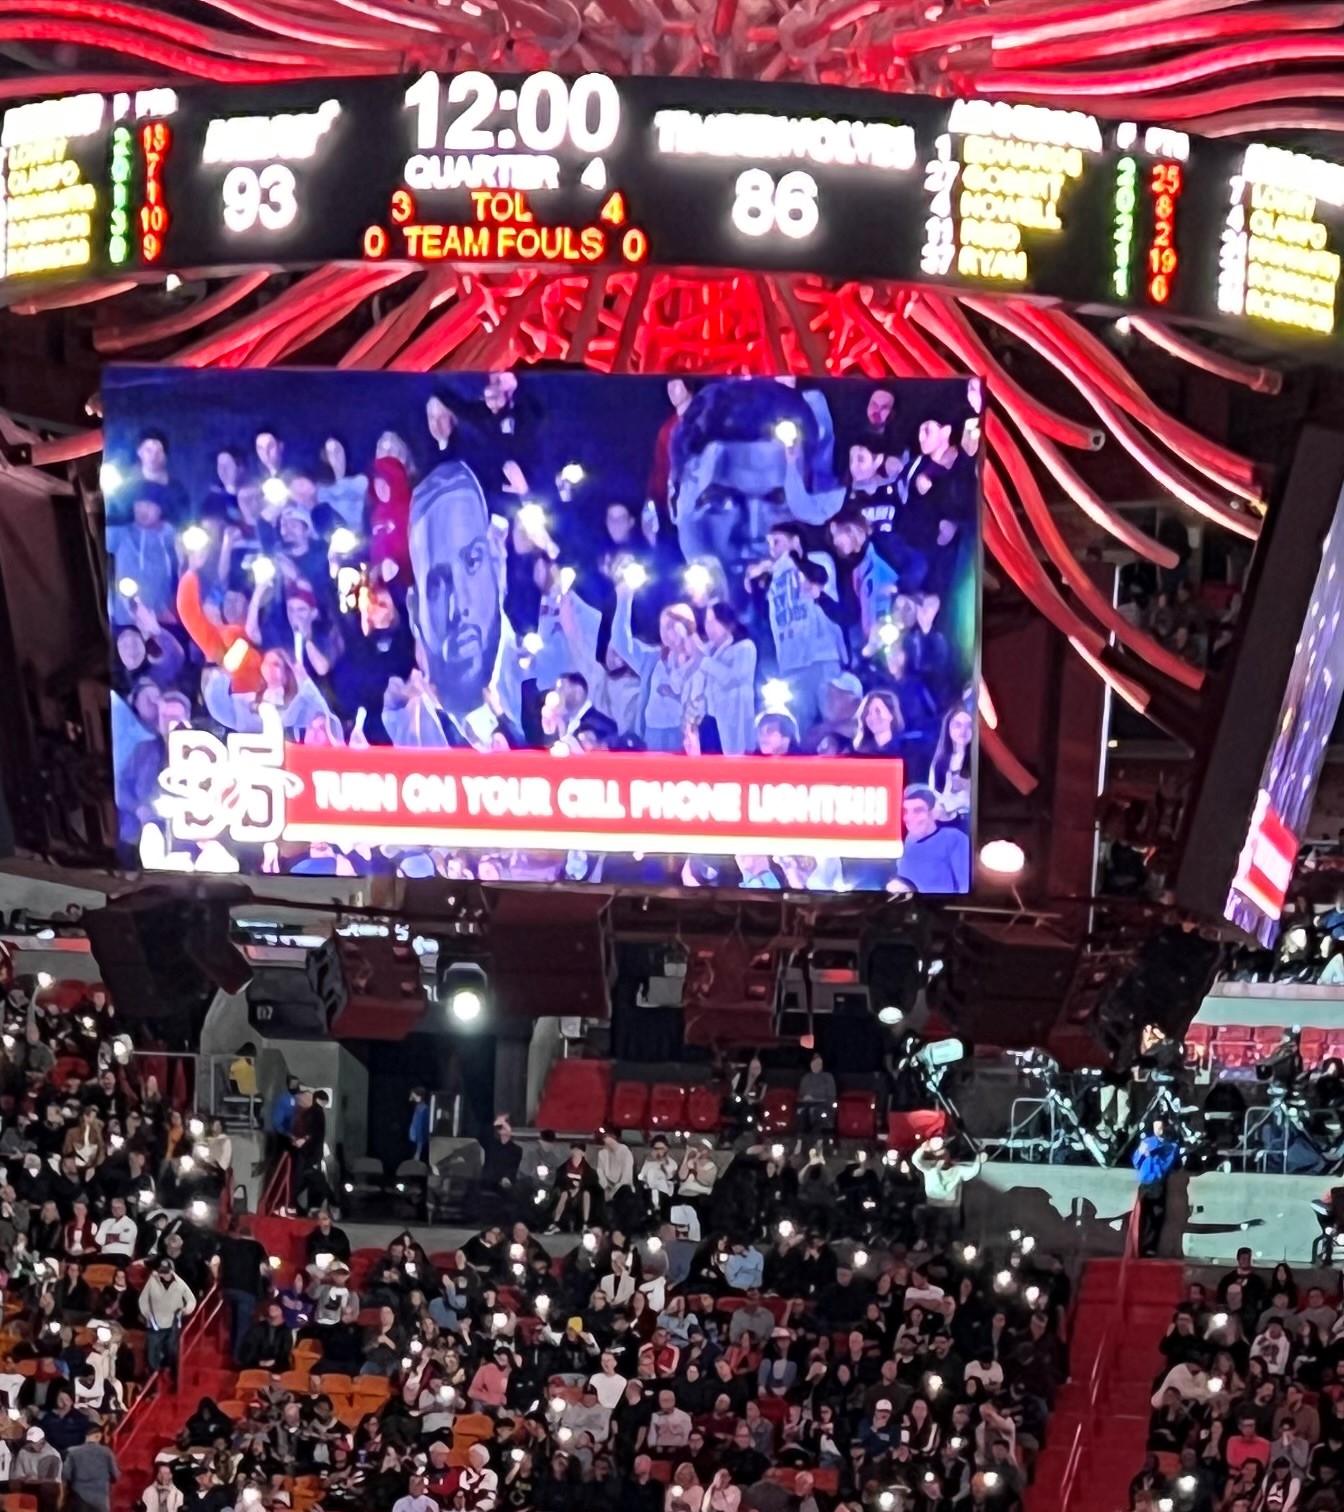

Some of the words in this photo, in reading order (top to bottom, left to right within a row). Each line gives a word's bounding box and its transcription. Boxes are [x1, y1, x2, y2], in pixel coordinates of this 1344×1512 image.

[404, 70, 620, 152] 12:00
[223, 164, 298, 232] 93
[404, 153, 560, 190] QUARTER
[581, 157, 607, 190] 4
[391, 190, 414, 222] 3
[471, 191, 534, 223] TOL
[600, 191, 625, 226] 4
[732, 168, 819, 239] 86
[364, 227, 387, 258] 0
[402, 226, 490, 260] TEAM
[496, 227, 605, 261] FOULS
[622, 228, 646, 262] 0
[312, 770, 398, 812] TURN
[402, 773, 457, 815] ON
[460, 774, 553, 816] YOUR
[557, 777, 625, 819] CELL
[630, 780, 742, 823] PHONE
